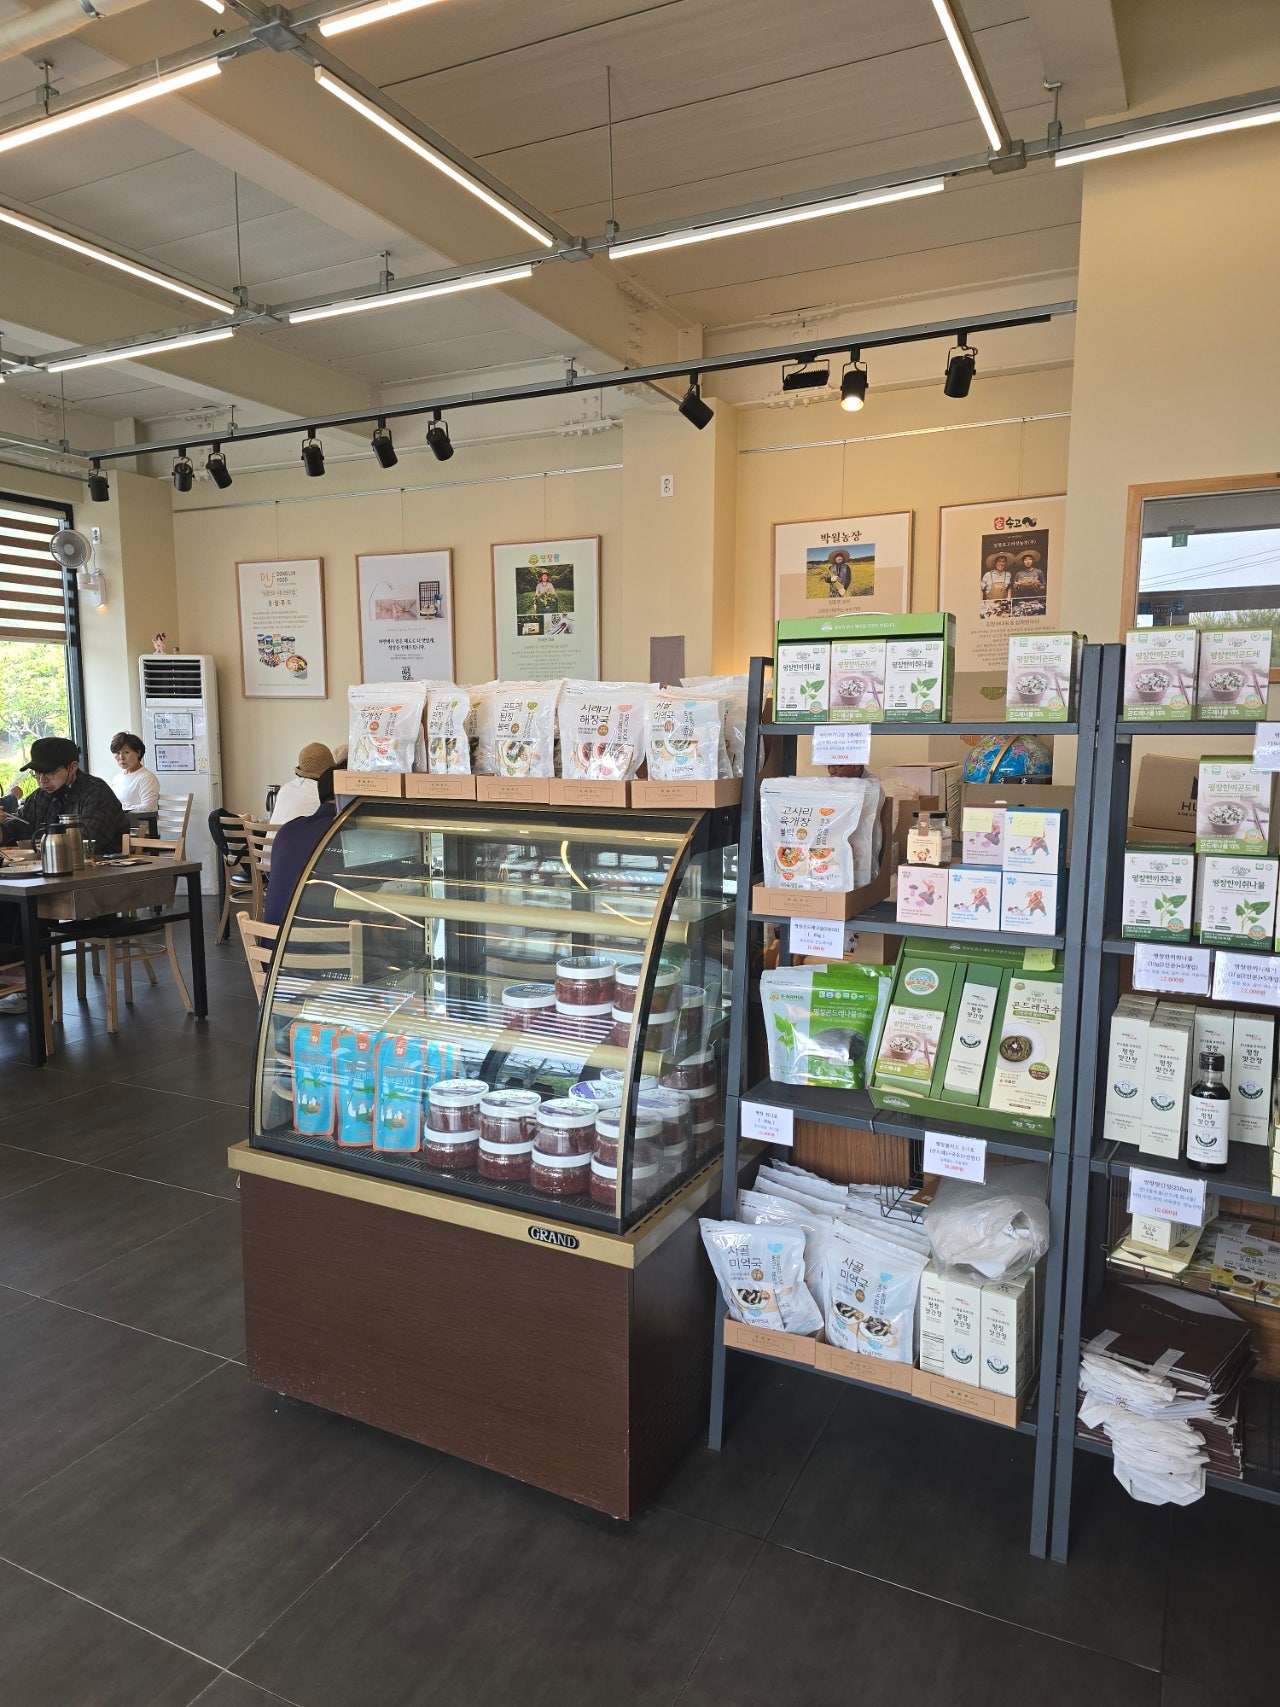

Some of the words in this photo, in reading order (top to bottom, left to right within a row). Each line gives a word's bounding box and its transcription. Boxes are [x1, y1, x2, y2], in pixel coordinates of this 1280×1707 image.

[580, 704, 612, 714] 시래기
[580, 714, 609, 726] 해장국
[782, 806, 813, 817] 고사리
[780, 816, 811, 827] 육개장
[1012, 1002, 1060, 1014] 곤드레국수
[1122, 1048, 1134, 1056] 평창
[1206, 1044, 1219, 1052] 평창
[1246, 1048, 1260, 1056] 평창
[1118, 1054, 1138, 1064] 맛간장
[1160, 1060, 1172, 1068] 평창
[1242, 1056, 1262, 1064] 맛간장
[1155, 1066, 1176, 1076] 맛간장
[1201, 1112, 1213, 1120] 평창
[530, 1227, 576, 1248] GRAND
[728, 1244, 750, 1256] 사골
[730, 1258, 762, 1270] 미역국
[842, 1258, 864, 1274] 사골
[840, 1269, 868, 1290] 미역국
[956, 1313, 968, 1322] 평창
[954, 1320, 972, 1330] 맛간장
[992, 1324, 1004, 1332] 평창
[989, 1330, 1007, 1340] 맛간장
